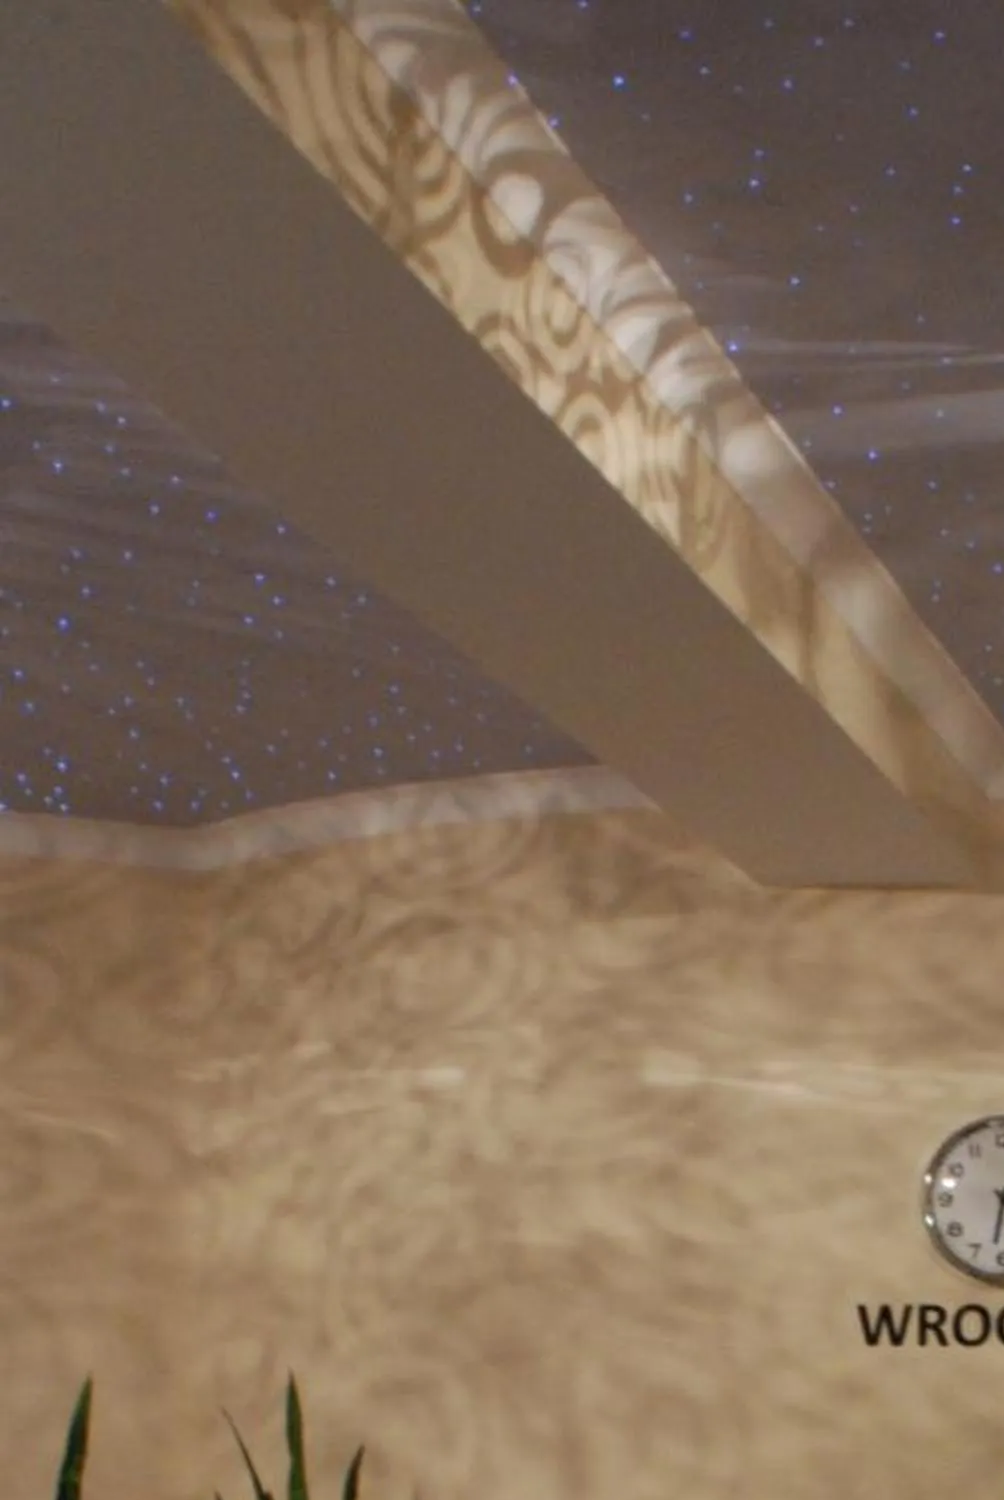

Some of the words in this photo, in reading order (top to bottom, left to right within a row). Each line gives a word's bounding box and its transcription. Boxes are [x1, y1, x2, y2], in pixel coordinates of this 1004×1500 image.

[950, 1163, 964, 1177] 10
[939, 1193, 953, 1207] 9
[947, 1222, 963, 1237] 8
[968, 1243, 982, 1258] 7
